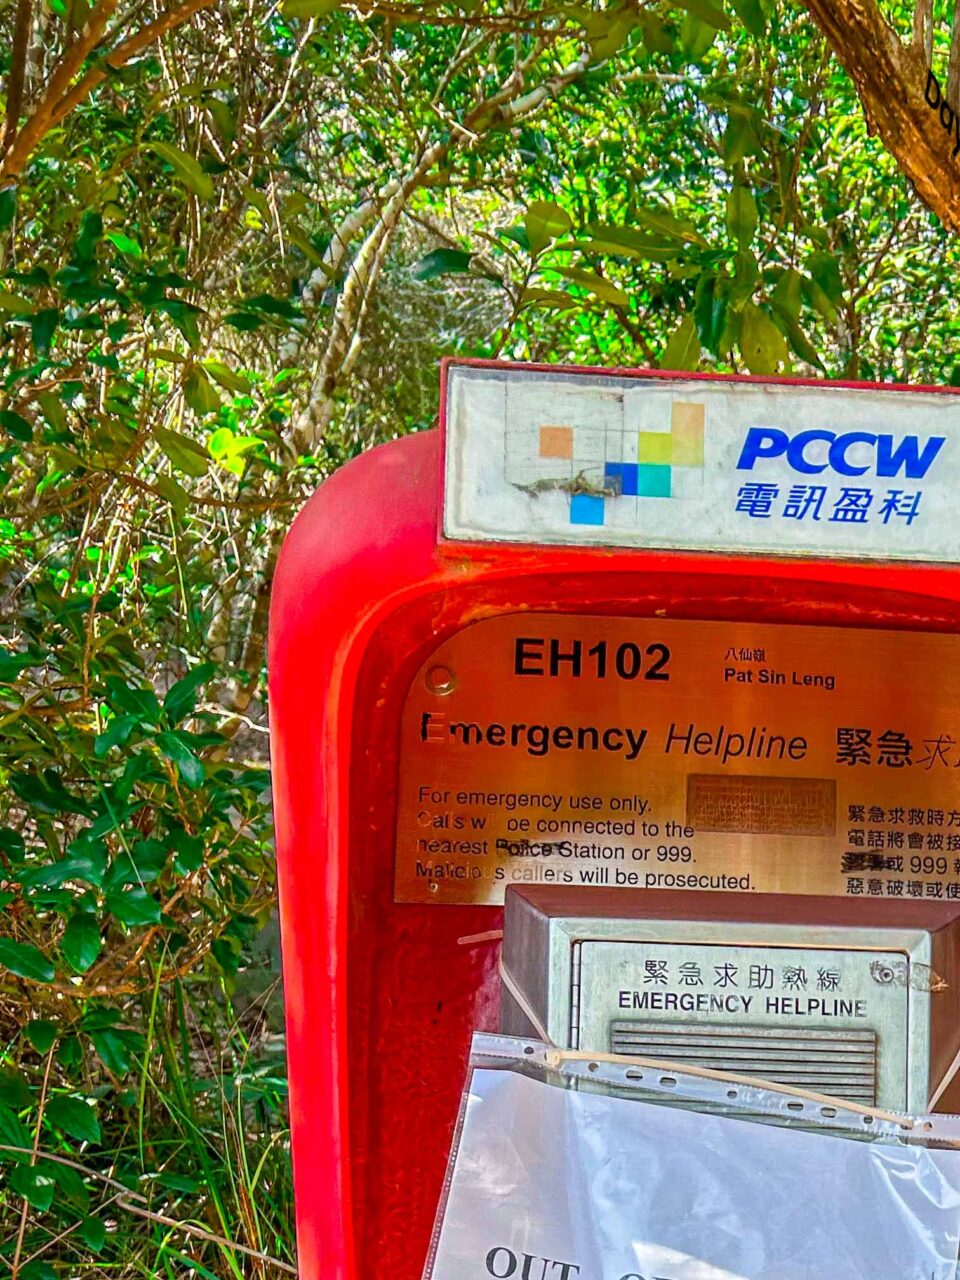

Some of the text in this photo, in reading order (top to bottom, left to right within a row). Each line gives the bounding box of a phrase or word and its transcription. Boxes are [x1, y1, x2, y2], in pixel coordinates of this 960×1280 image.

[736, 427, 947, 479] PCCW
[735, 483, 923, 525] 電訊盈科
[514, 637, 671, 682] EH102
[724, 648, 766, 663] 八仙嶺
[724, 668, 835, 691] Pat Sin Leng
[421, 712, 808, 764] Emergency Helpline
[418, 787, 652, 815] For emergency use only.
[536, 817, 635, 836] connected
[641, 821, 658, 837] to
[665, 819, 695, 838] the
[416, 838, 488, 855] nearest
[559, 841, 625, 859] Station
[631, 848, 650, 861] or
[656, 845, 697, 863] 999.
[579, 867, 609, 884] will
[616, 868, 639, 885] be
[645, 871, 756, 891] prosecuted.
[643, 959, 843, 993] 緊急求助熱線
[618, 990, 868, 1018] EMERGENCY HELPLINE
